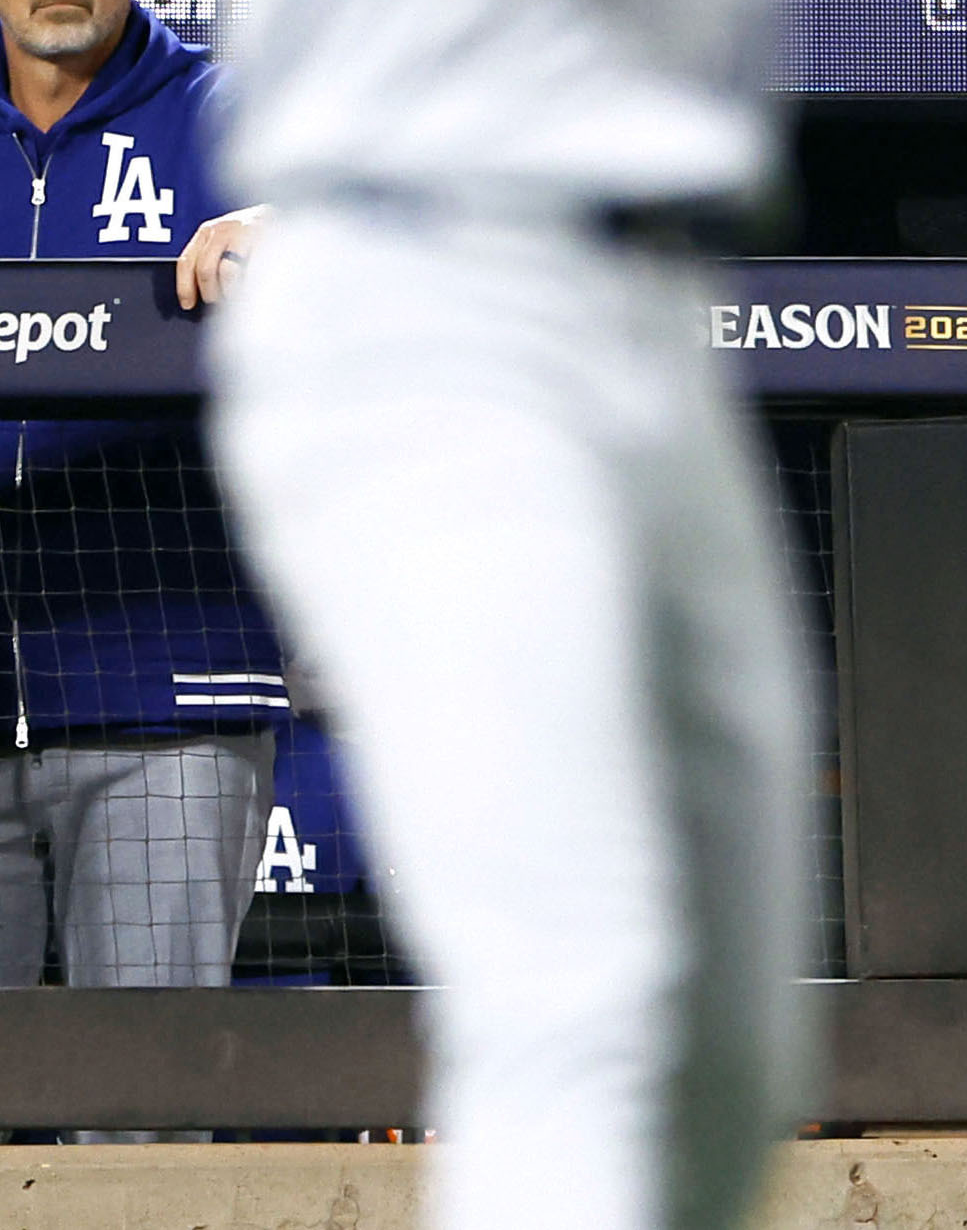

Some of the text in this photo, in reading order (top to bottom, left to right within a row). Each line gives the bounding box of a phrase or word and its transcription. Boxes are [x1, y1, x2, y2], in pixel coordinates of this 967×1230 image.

[92, 133, 174, 244] LA
[0, 303, 112, 364] epot
[710, 304, 892, 349] EASON
